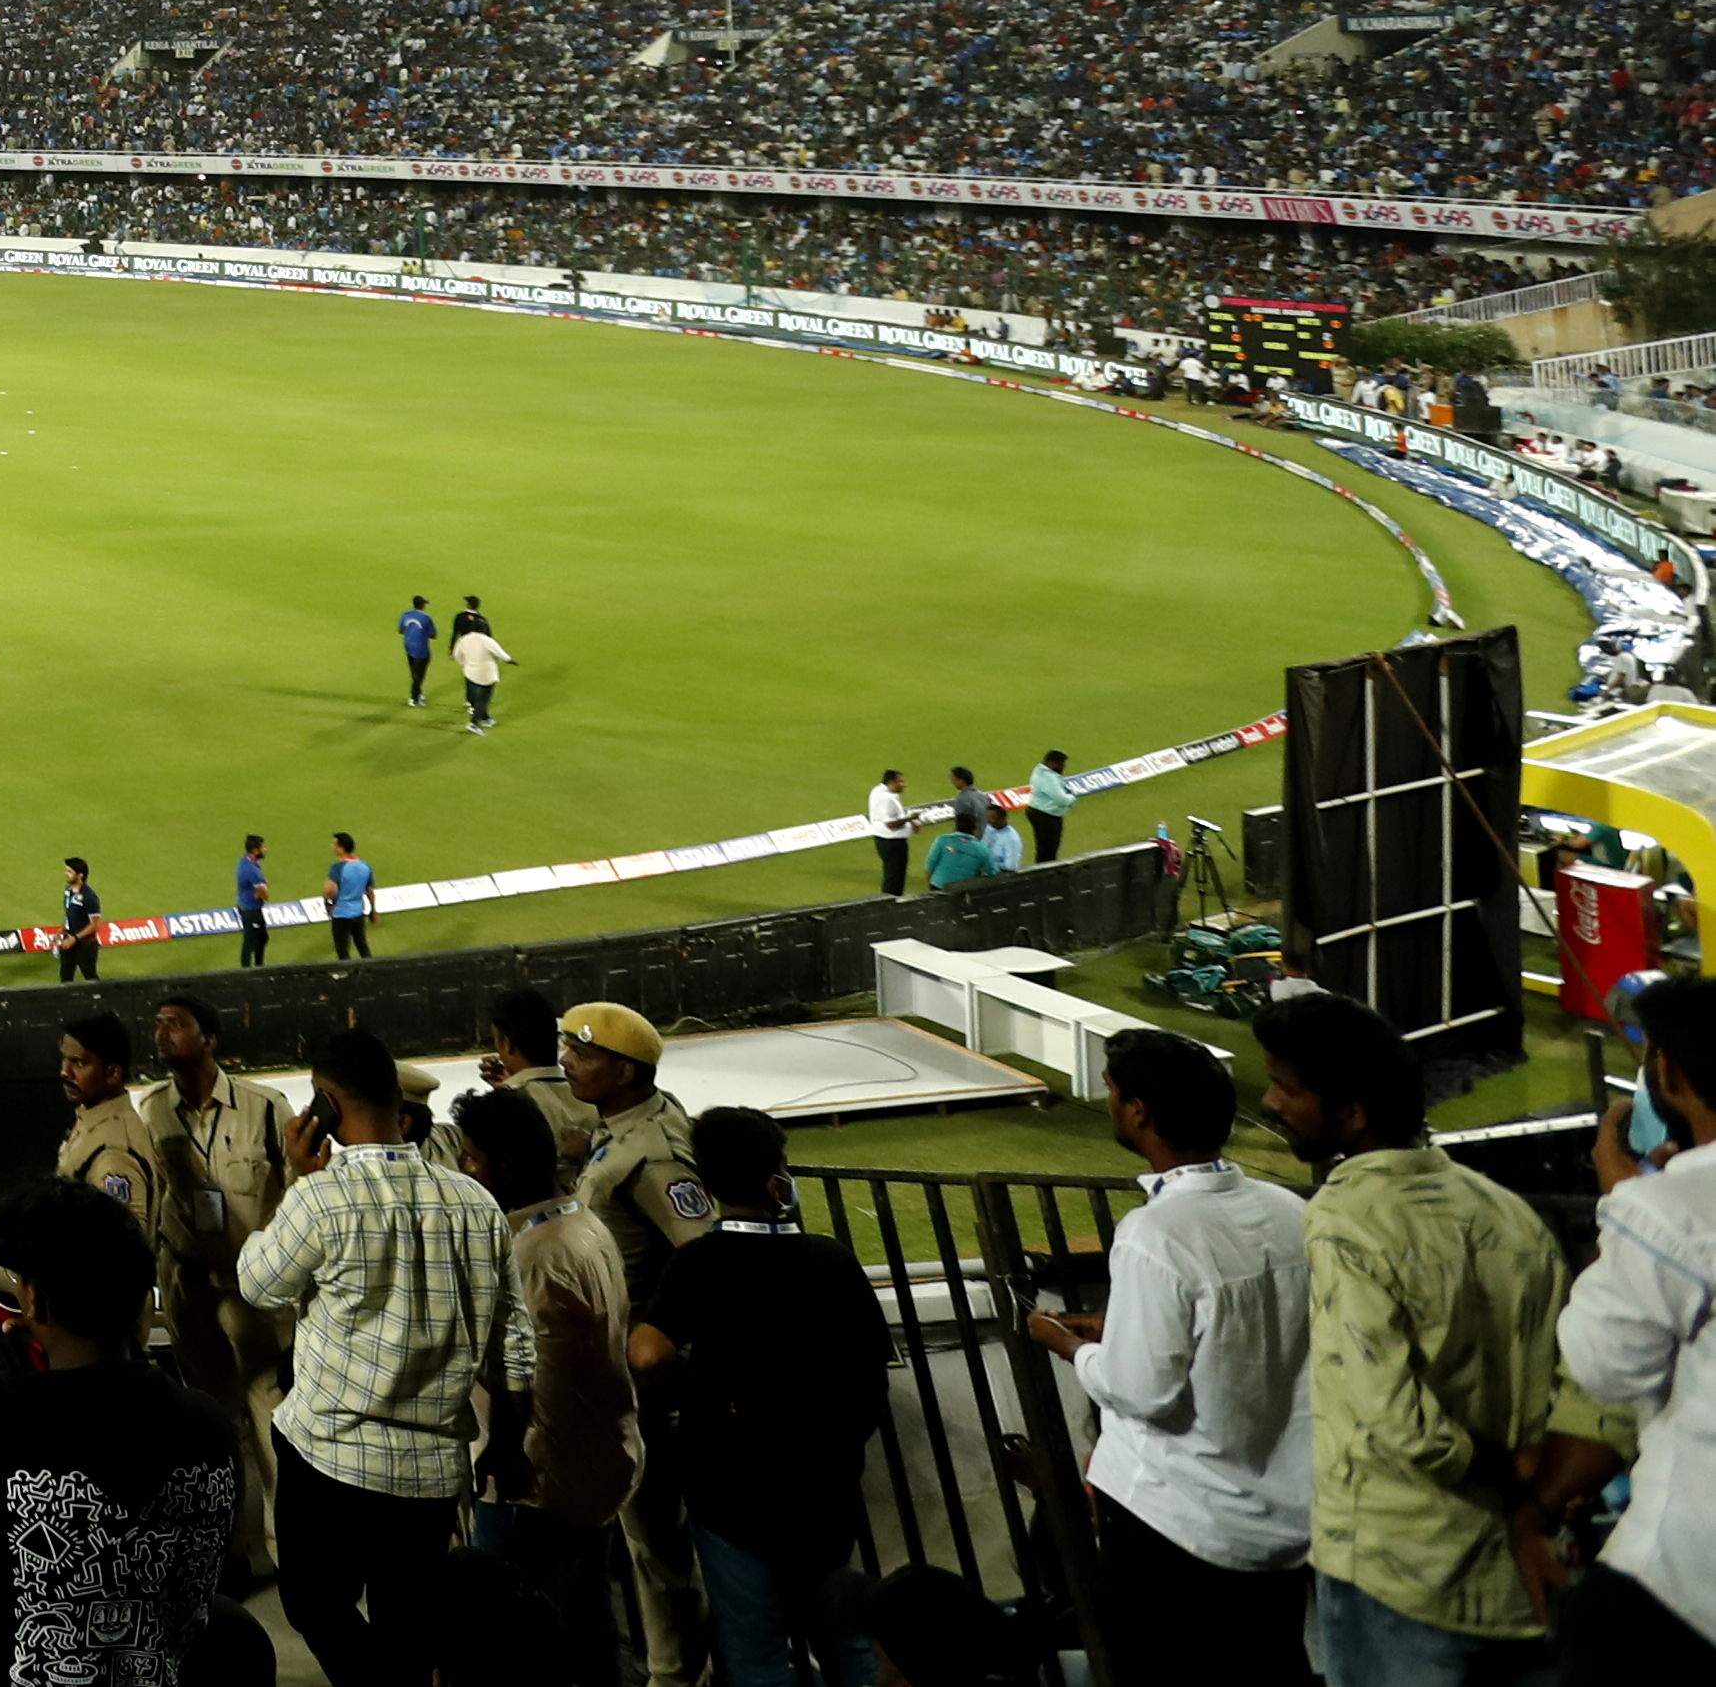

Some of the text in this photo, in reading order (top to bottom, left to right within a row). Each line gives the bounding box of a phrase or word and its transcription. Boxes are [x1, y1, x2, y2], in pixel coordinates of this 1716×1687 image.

[224, 262, 308, 281] ROYAL GREEN
[677, 303, 773, 327] ROYAL GREEN
[969, 339, 1056, 370] ROYAL GREEN
[108, 922, 160, 944] Amul
[169, 911, 236, 935] ASTRAL
